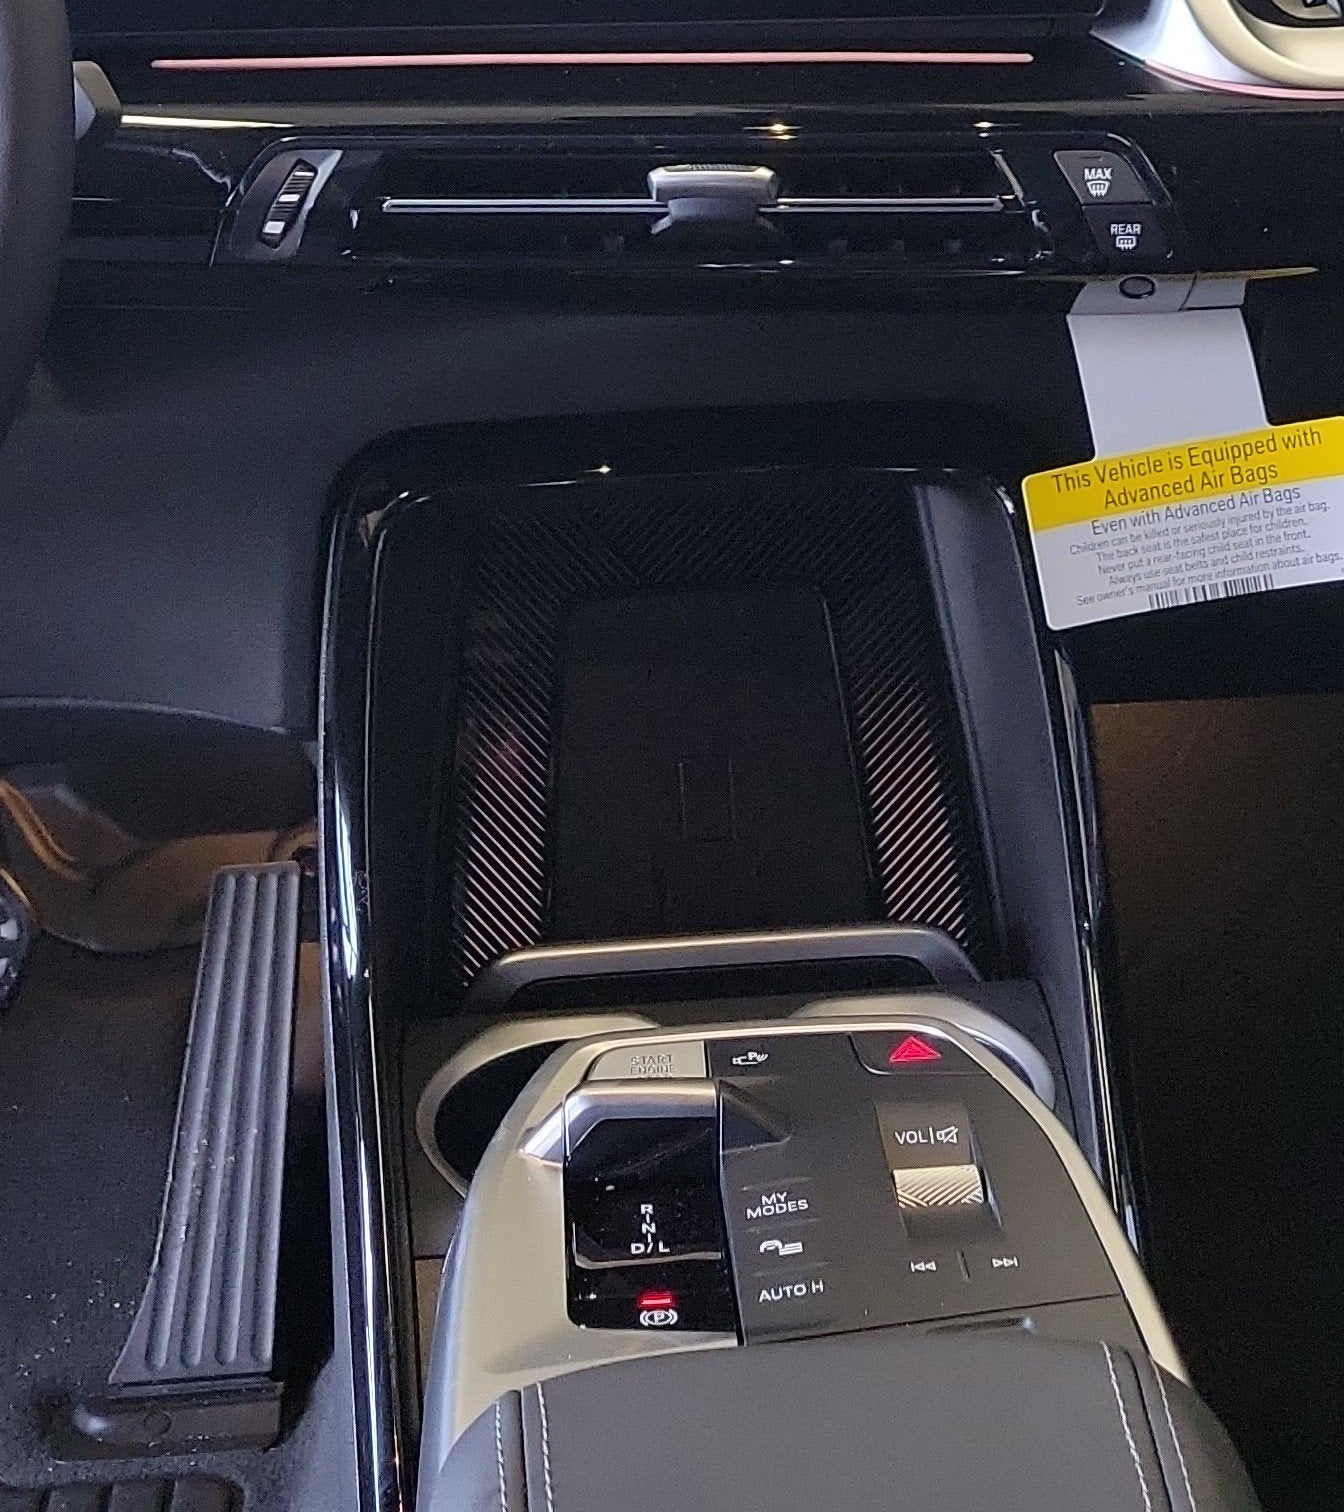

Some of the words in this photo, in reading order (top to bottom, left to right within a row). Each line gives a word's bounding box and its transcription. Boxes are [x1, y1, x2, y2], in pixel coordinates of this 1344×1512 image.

[1084, 167, 1113, 180] MAX
[1110, 223, 1142, 235] REAR
[1050, 470, 1091, 494] This
[1094, 454, 1164, 484] Vehicle
[1167, 452, 1184, 470] is
[1188, 432, 1277, 468] Equipped
[1280, 426, 1322, 450] with
[1104, 474, 1195, 509] Advanced
[1200, 468, 1224, 491] Air
[1230, 464, 1278, 486] Bags
[1092, 518, 1126, 535] Even
[1130, 508, 1160, 528] with
[1164, 494, 1235, 521] Advanced
[1240, 490, 1260, 508] Air
[1262, 486, 1302, 504] Bags
[1262, 508, 1274, 522] by
[1276, 506, 1292, 516] the
[1294, 502, 1305, 514] air
[1094, 552, 1114, 562] The
[1098, 562, 1126, 575] Never
[1266, 534, 1282, 545] the
[1076, 594, 1095, 606] See
[1272, 556, 1303, 570] about
[630, 1053, 673, 1065] START
[894, 1129, 929, 1146] VOL
[761, 1192, 787, 1206] MY
[640, 1203, 654, 1215] R
[746, 1199, 809, 1219] MODES
[641, 1222, 656, 1234] N
[758, 1284, 807, 1303] AUTO
[810, 1280, 824, 1294] H
